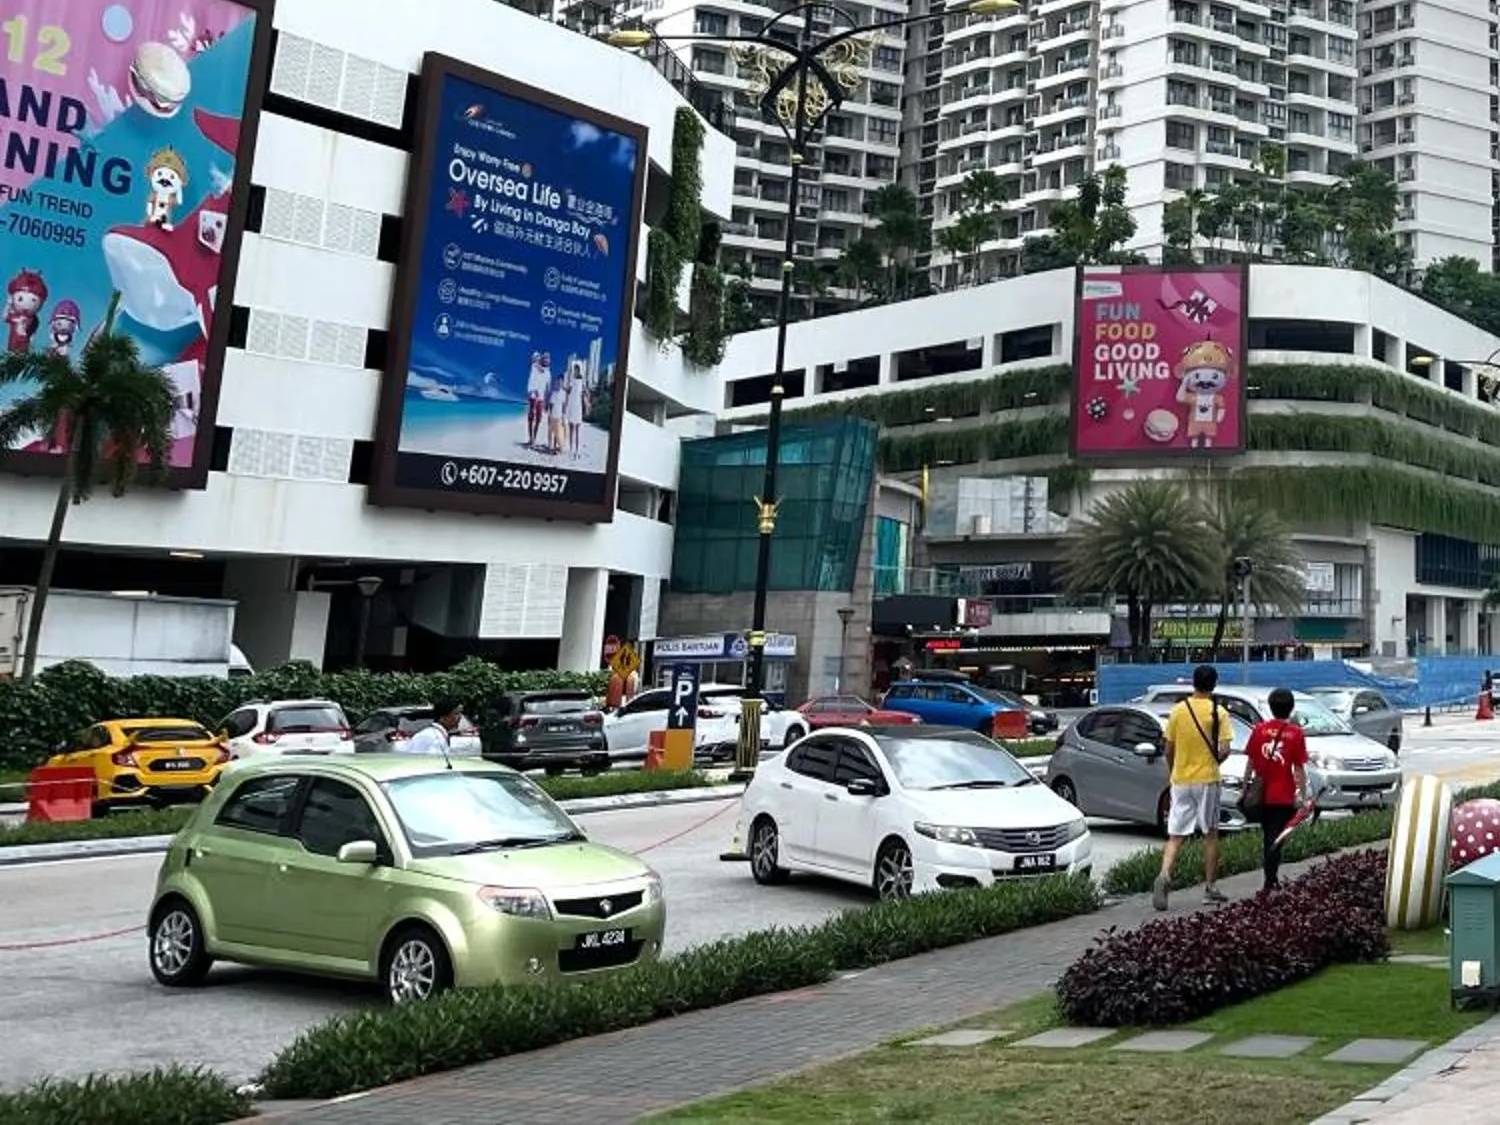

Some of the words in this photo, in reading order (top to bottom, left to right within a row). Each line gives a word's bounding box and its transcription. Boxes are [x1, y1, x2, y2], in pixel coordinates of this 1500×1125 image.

[3, 14, 71, 76] 12
[450, 158, 528, 200] Oversea
[532, 182, 561, 209] Life
[38, 192, 93, 219] TREND
[474, 194, 488, 212] By
[491, 198, 522, 222] Living
[571, 222, 592, 241] Bay
[1096, 302, 1140, 321] FUN
[1095, 322, 1156, 341] FOOD
[1094, 343, 1160, 362] GOOD
[1093, 361, 1171, 380] LIVING
[675, 680, 694, 706] P
